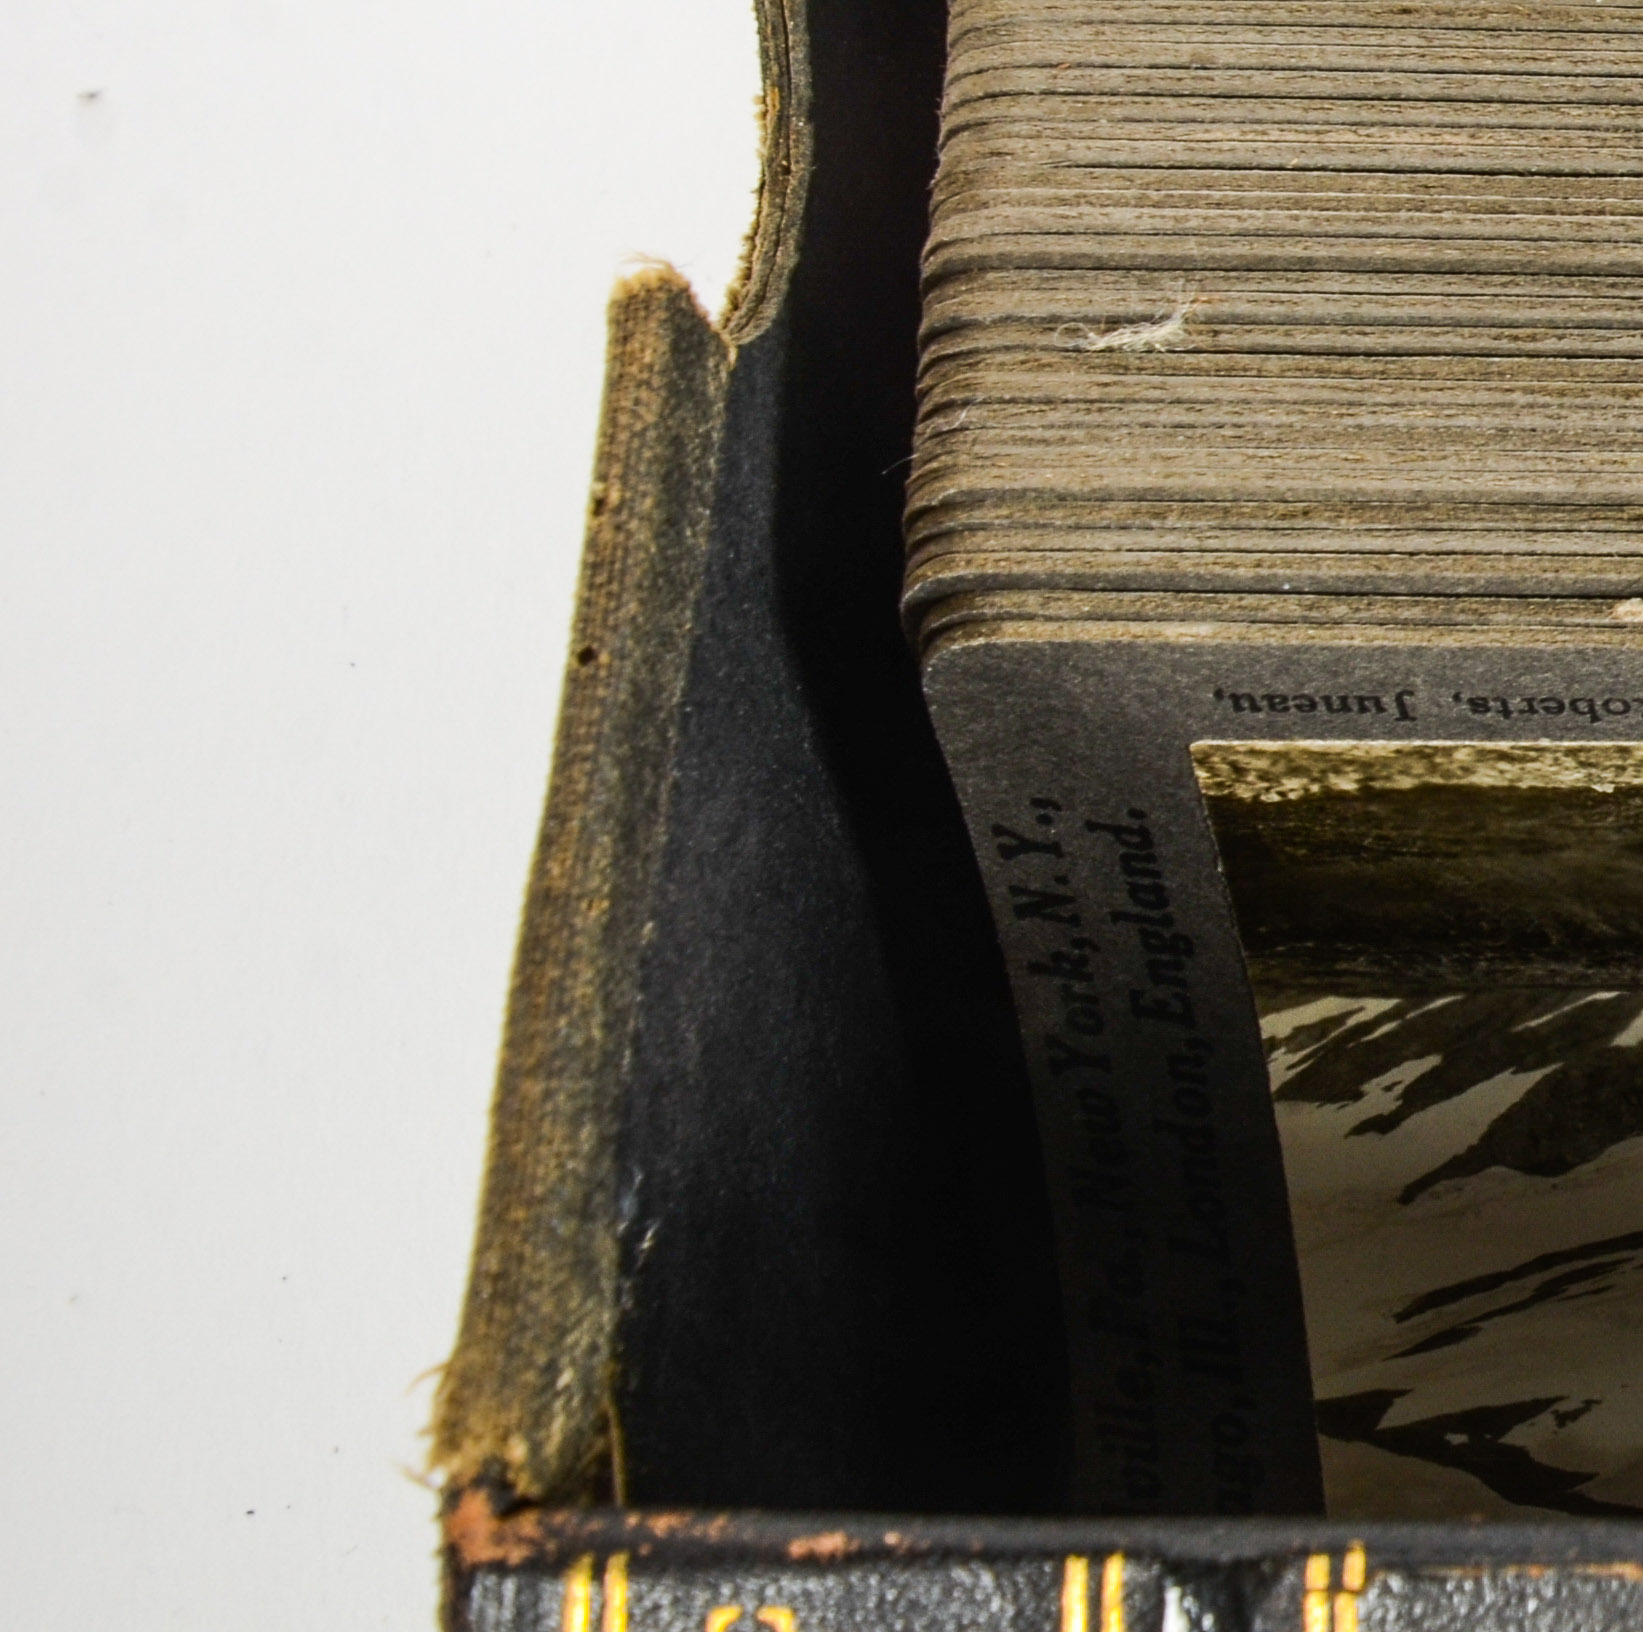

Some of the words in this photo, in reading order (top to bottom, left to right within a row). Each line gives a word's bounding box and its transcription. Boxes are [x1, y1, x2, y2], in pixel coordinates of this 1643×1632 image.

[1213, 688, 1418, 723] Juneau,
[1084, 808, 1196, 1030] England.
[1026, 937, 1112, 1077] York,
[1065, 1087, 1134, 1213] New
[1150, 1037, 1232, 1265] London,
